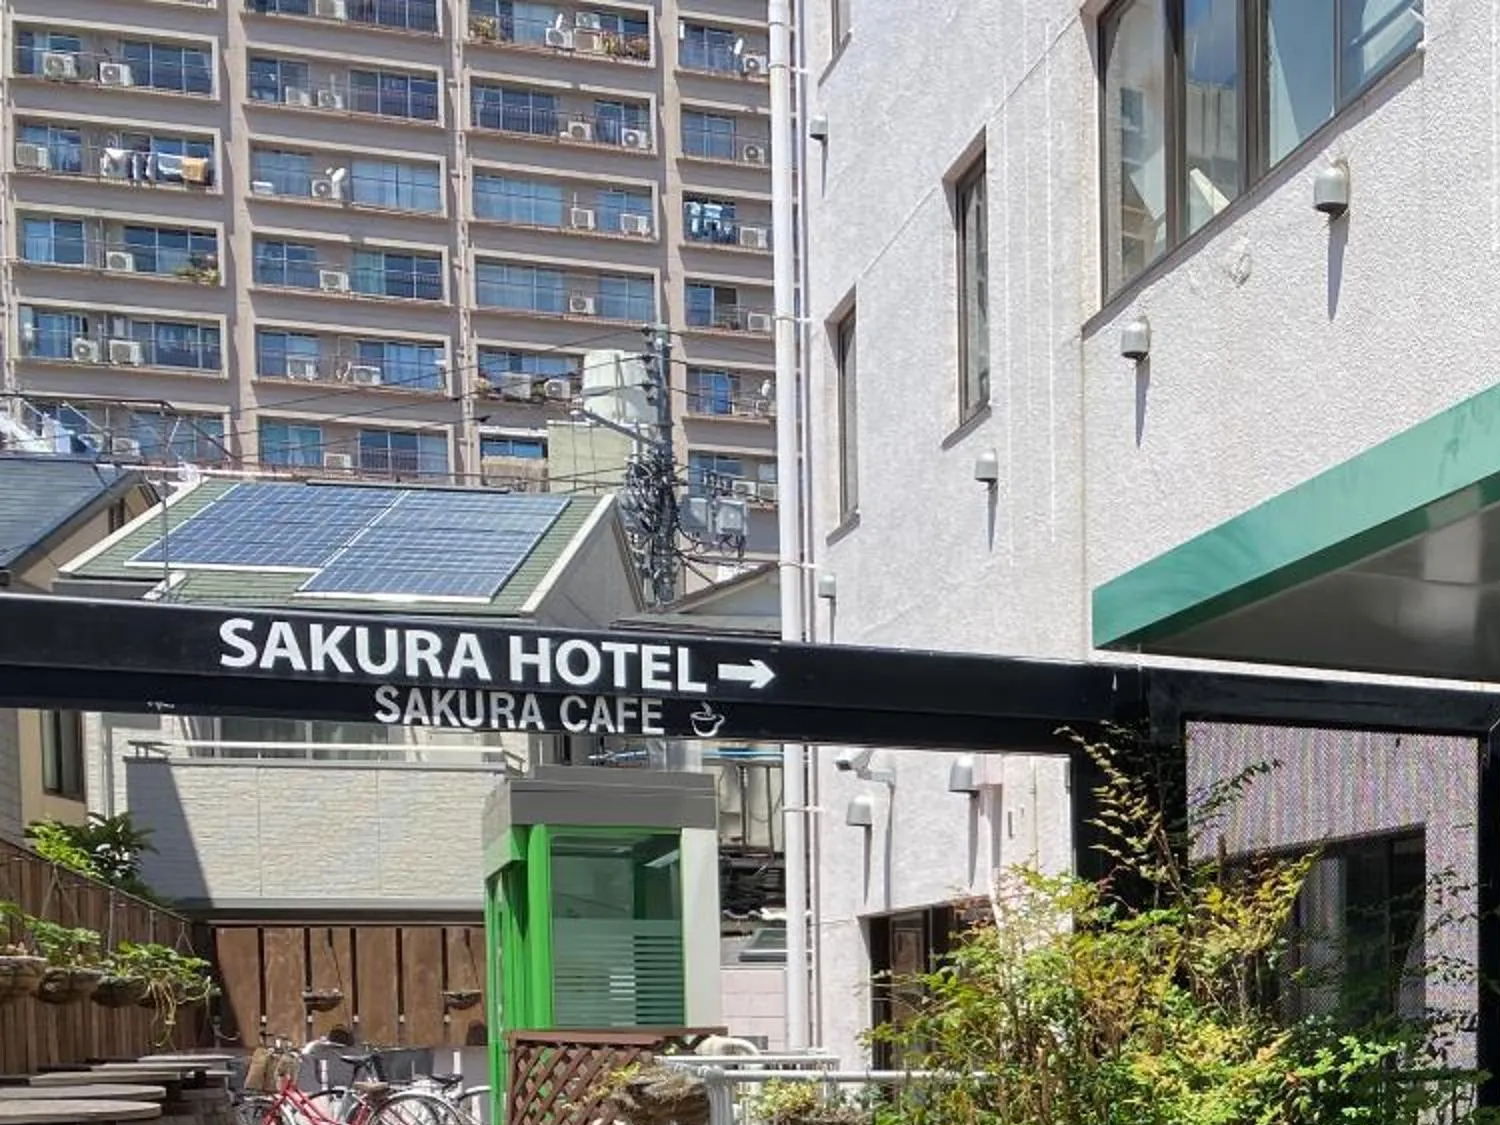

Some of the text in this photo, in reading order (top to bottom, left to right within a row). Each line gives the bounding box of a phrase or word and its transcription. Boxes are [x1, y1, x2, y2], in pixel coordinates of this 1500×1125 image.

[220, 618, 708, 693] SAKURA HOTEL
[374, 685, 665, 735] SAKURA CAFE
